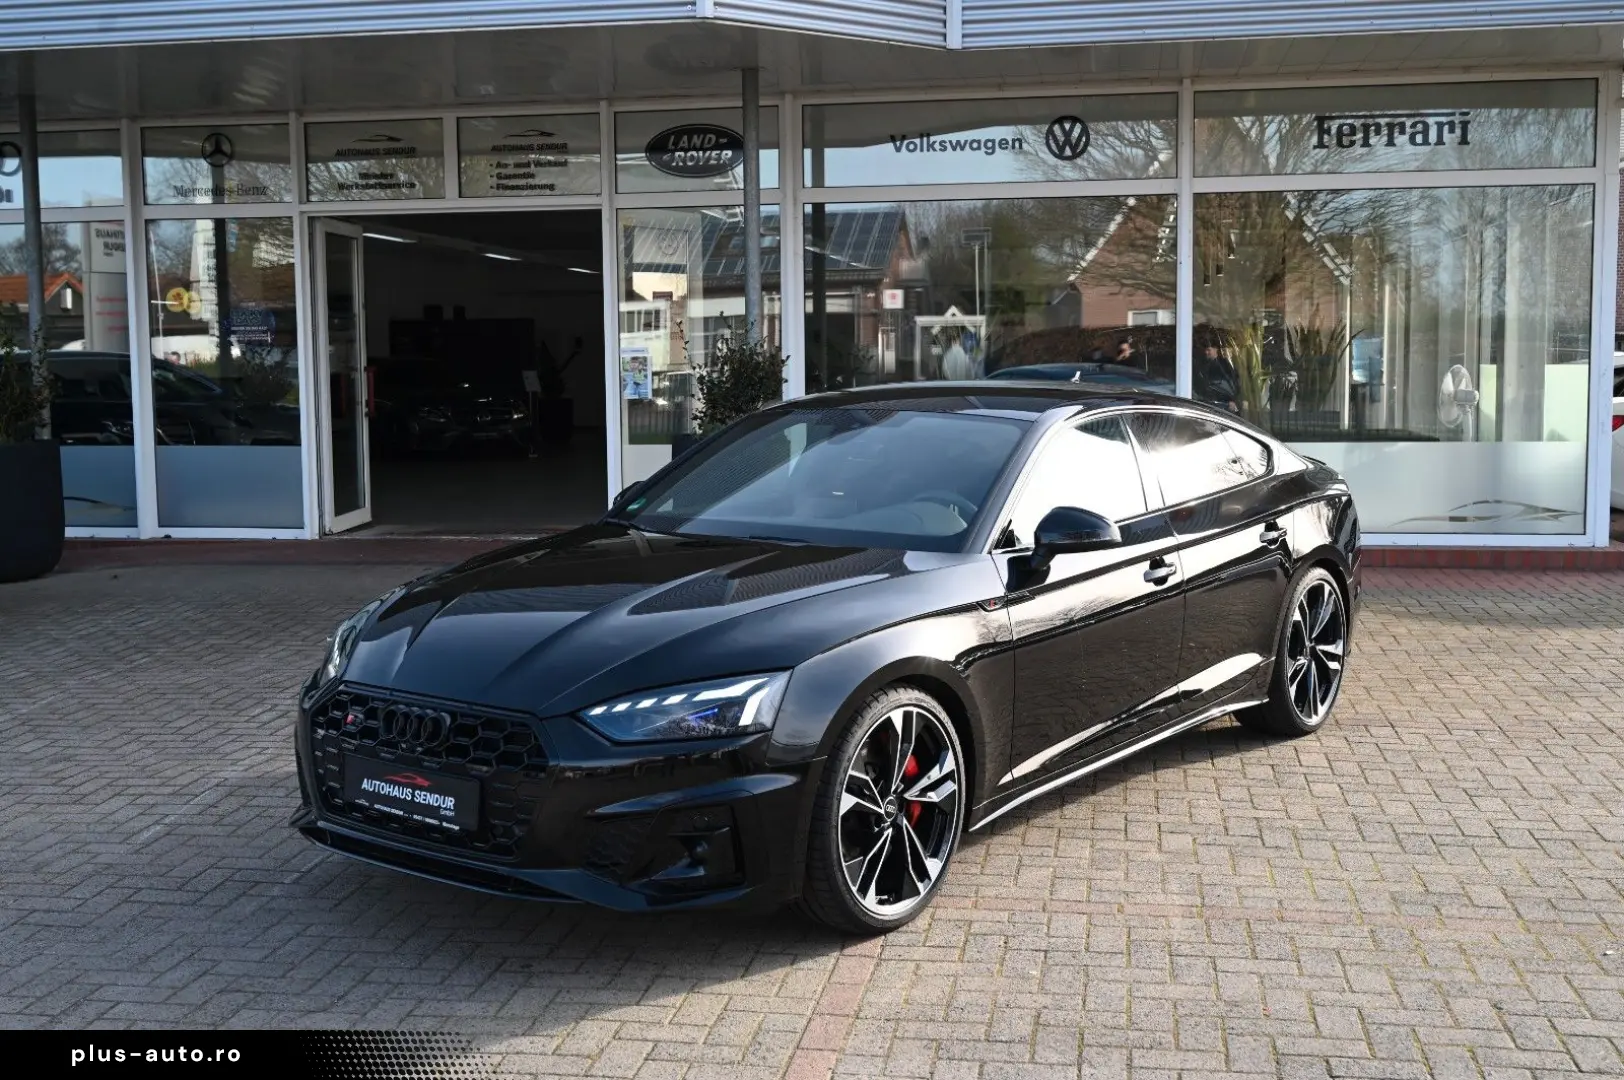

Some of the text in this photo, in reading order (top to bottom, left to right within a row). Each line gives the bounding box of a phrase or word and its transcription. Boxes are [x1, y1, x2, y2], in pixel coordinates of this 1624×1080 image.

[1313, 111, 1471, 149] Ferrari
[335, 146, 416, 157] AUTOHAUS SENDUR
[889, 133, 1023, 156] Volkswagen
[172, 183, 269, 198] Mercedes-Benz
[495, 181, 556, 192] Finanzierung
[361, 778, 455, 809] AUTOHAUS SENDUR
[440, 808, 455, 817] GmbH
